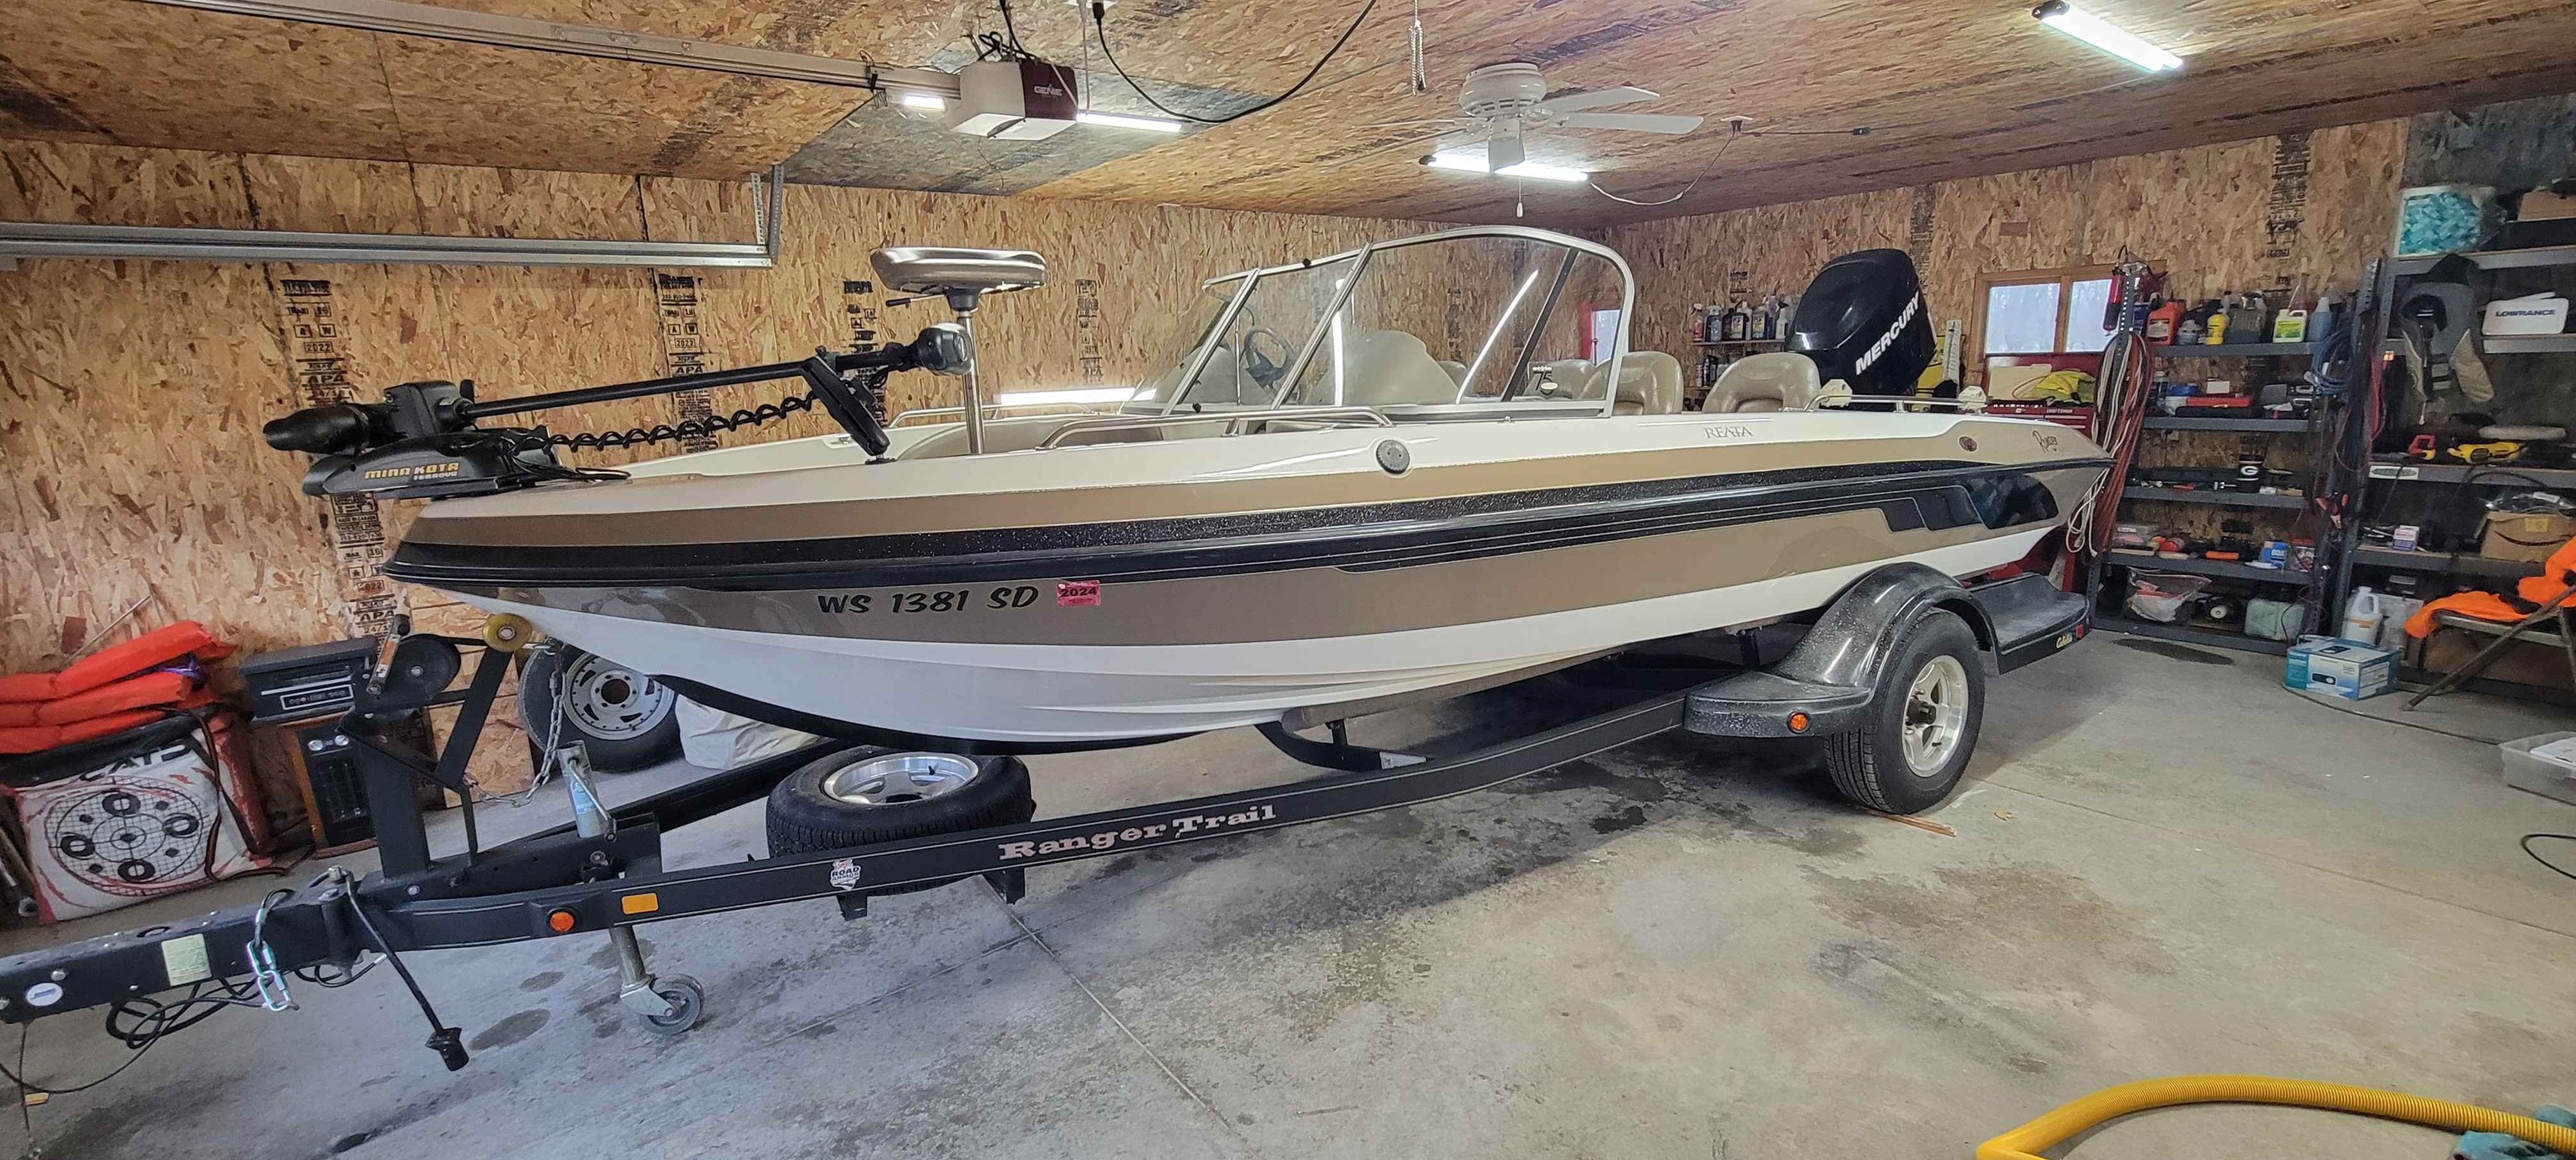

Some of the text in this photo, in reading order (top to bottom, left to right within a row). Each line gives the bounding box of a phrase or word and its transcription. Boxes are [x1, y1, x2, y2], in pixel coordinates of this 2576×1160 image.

[1855, 290, 1919, 376] MERCURY
[306, 343, 332, 352] 2022
[675, 366, 703, 374] APA
[307, 375, 344, 383] APA
[1703, 426, 1754, 438] REATA
[364, 461, 460, 480] MINN KOTA
[369, 548, 381, 556] 16
[1060, 587, 1098, 597] 2024
[817, 586, 1039, 614] WS 1381 SD
[360, 610, 395, 621] APA
[998, 805, 1276, 860] Ranger Trail
[832, 866, 860, 877] ROAD
